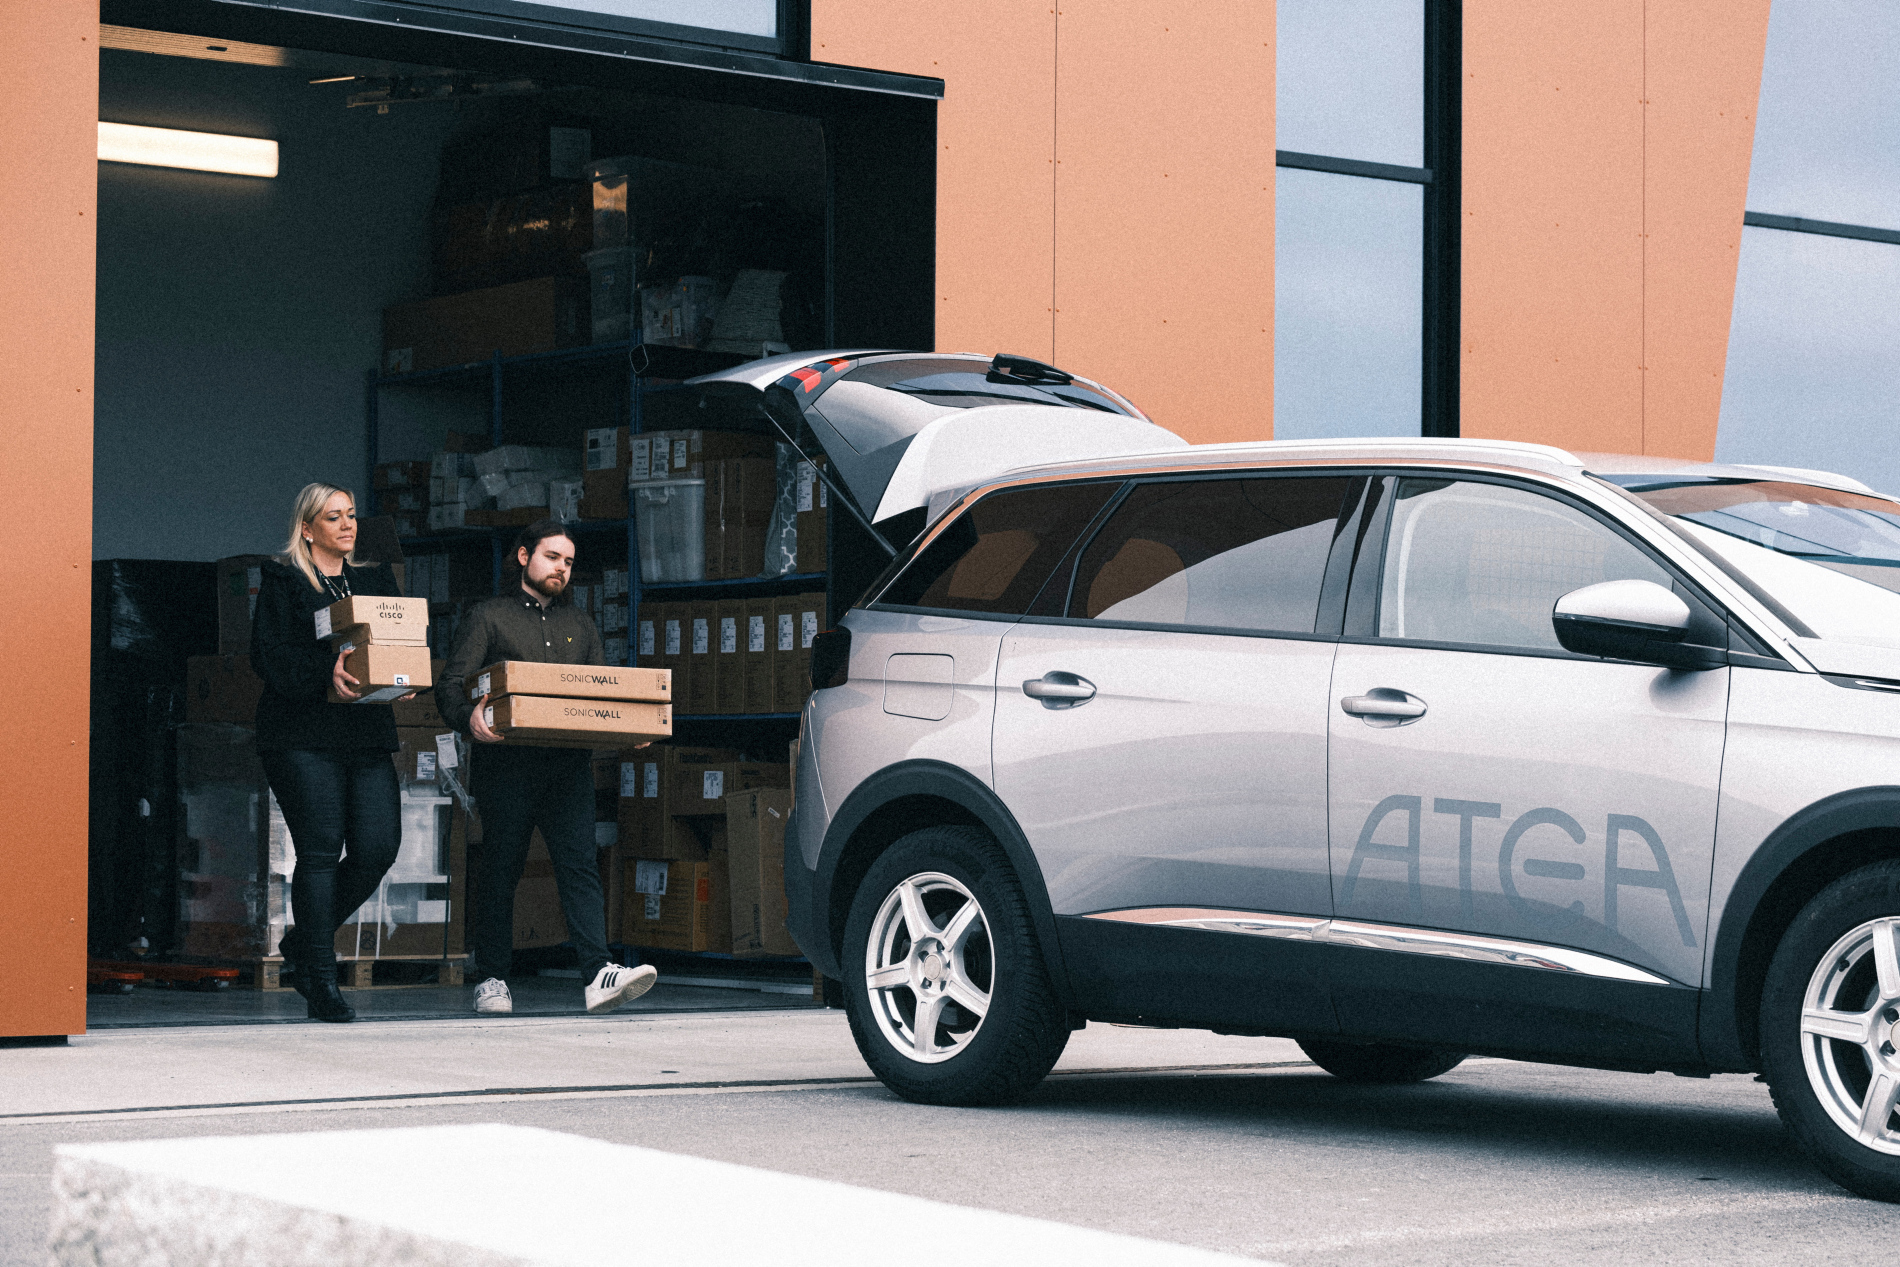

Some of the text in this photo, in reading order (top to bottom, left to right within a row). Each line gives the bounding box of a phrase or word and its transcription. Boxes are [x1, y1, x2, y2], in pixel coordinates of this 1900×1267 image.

[560, 673, 619, 686] SONICWALL
[563, 707, 623, 720] SONICWALL
[1340, 794, 1698, 948] ATEA
